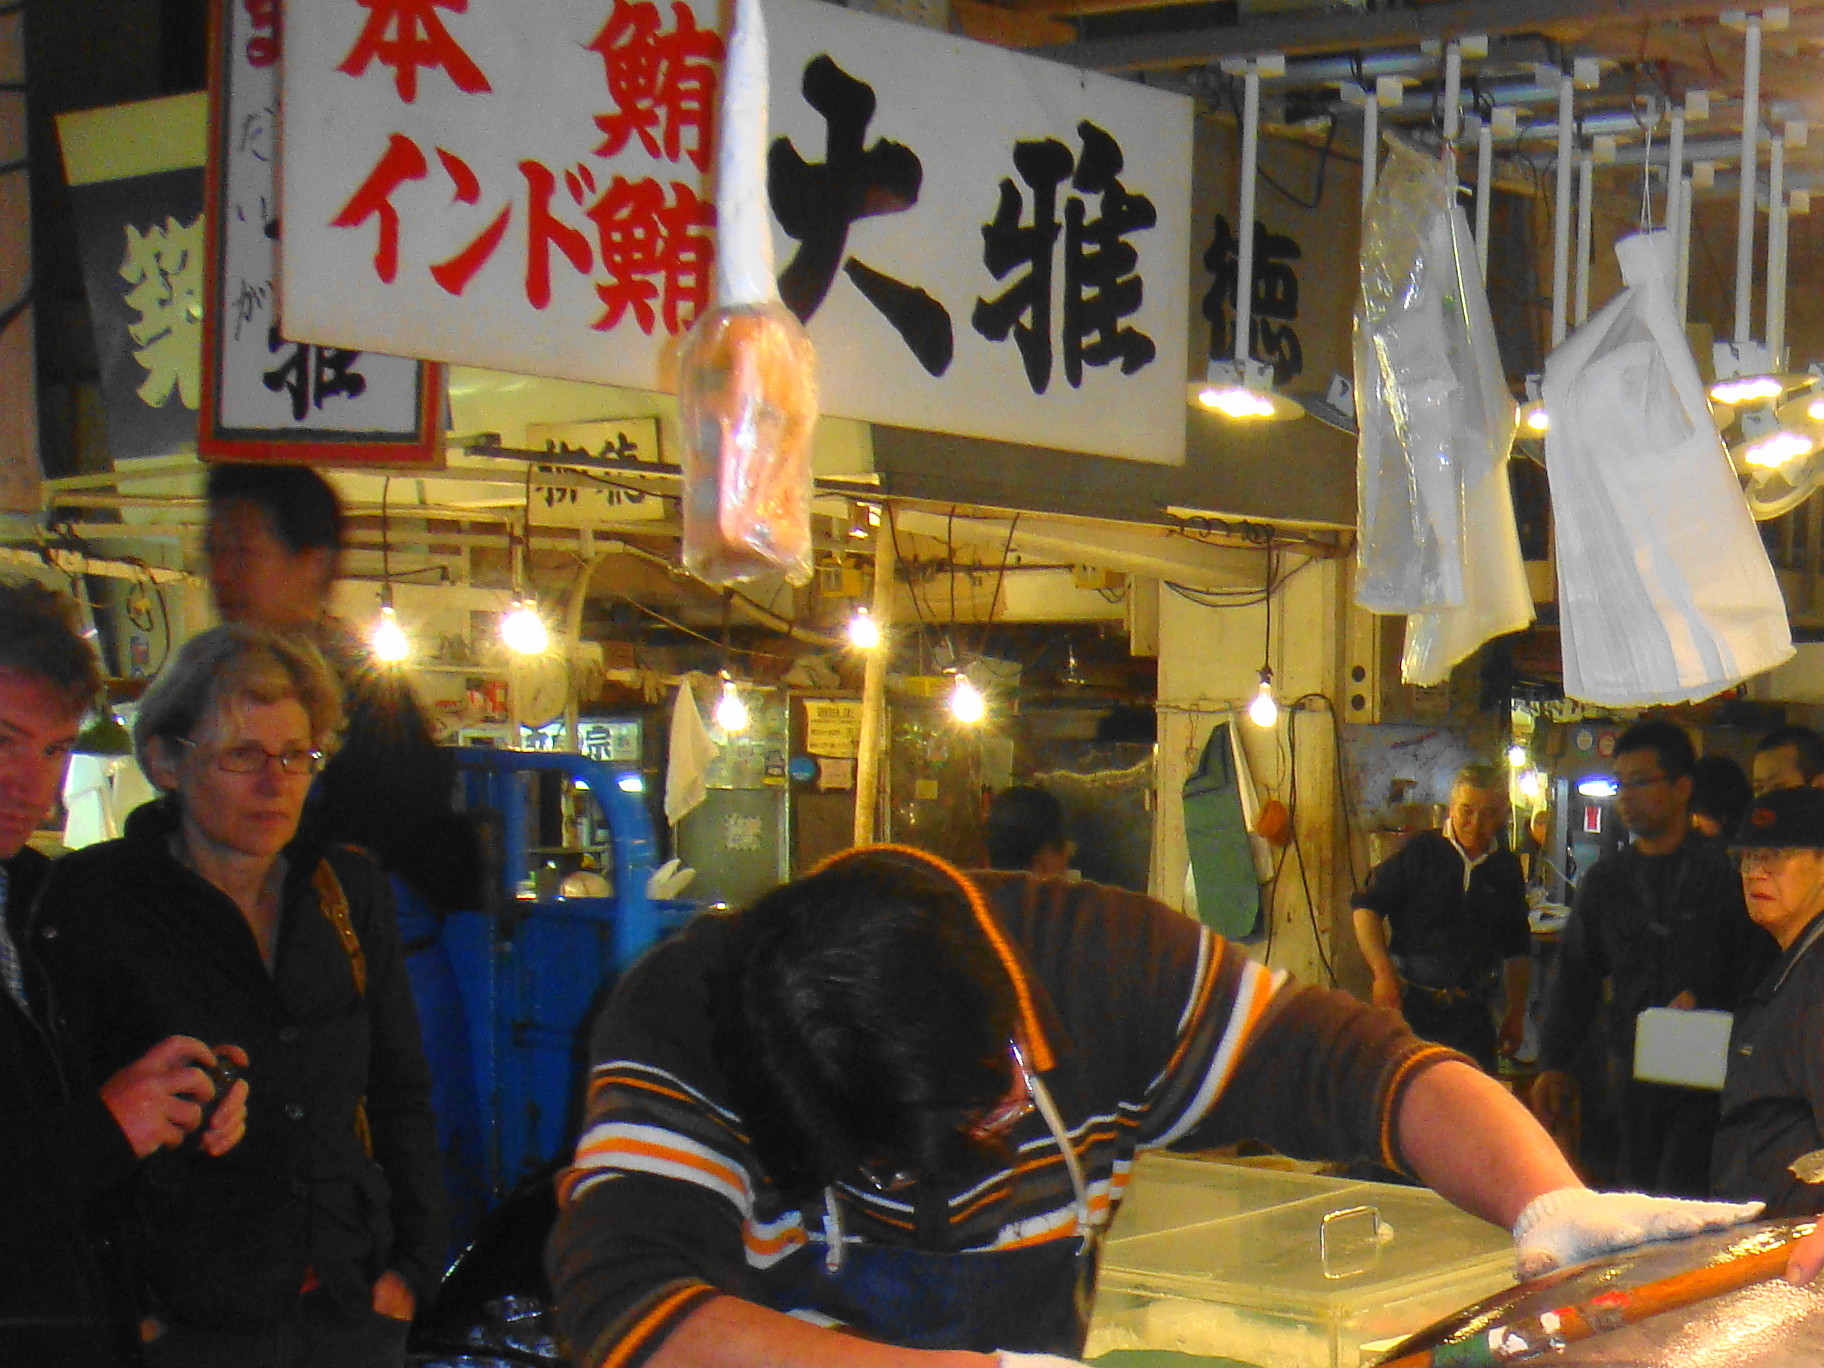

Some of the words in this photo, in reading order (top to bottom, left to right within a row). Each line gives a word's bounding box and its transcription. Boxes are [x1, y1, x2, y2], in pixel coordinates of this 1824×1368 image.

[329, 133, 720, 338] インド鮪
[767, 54, 1157, 395] 大雅
